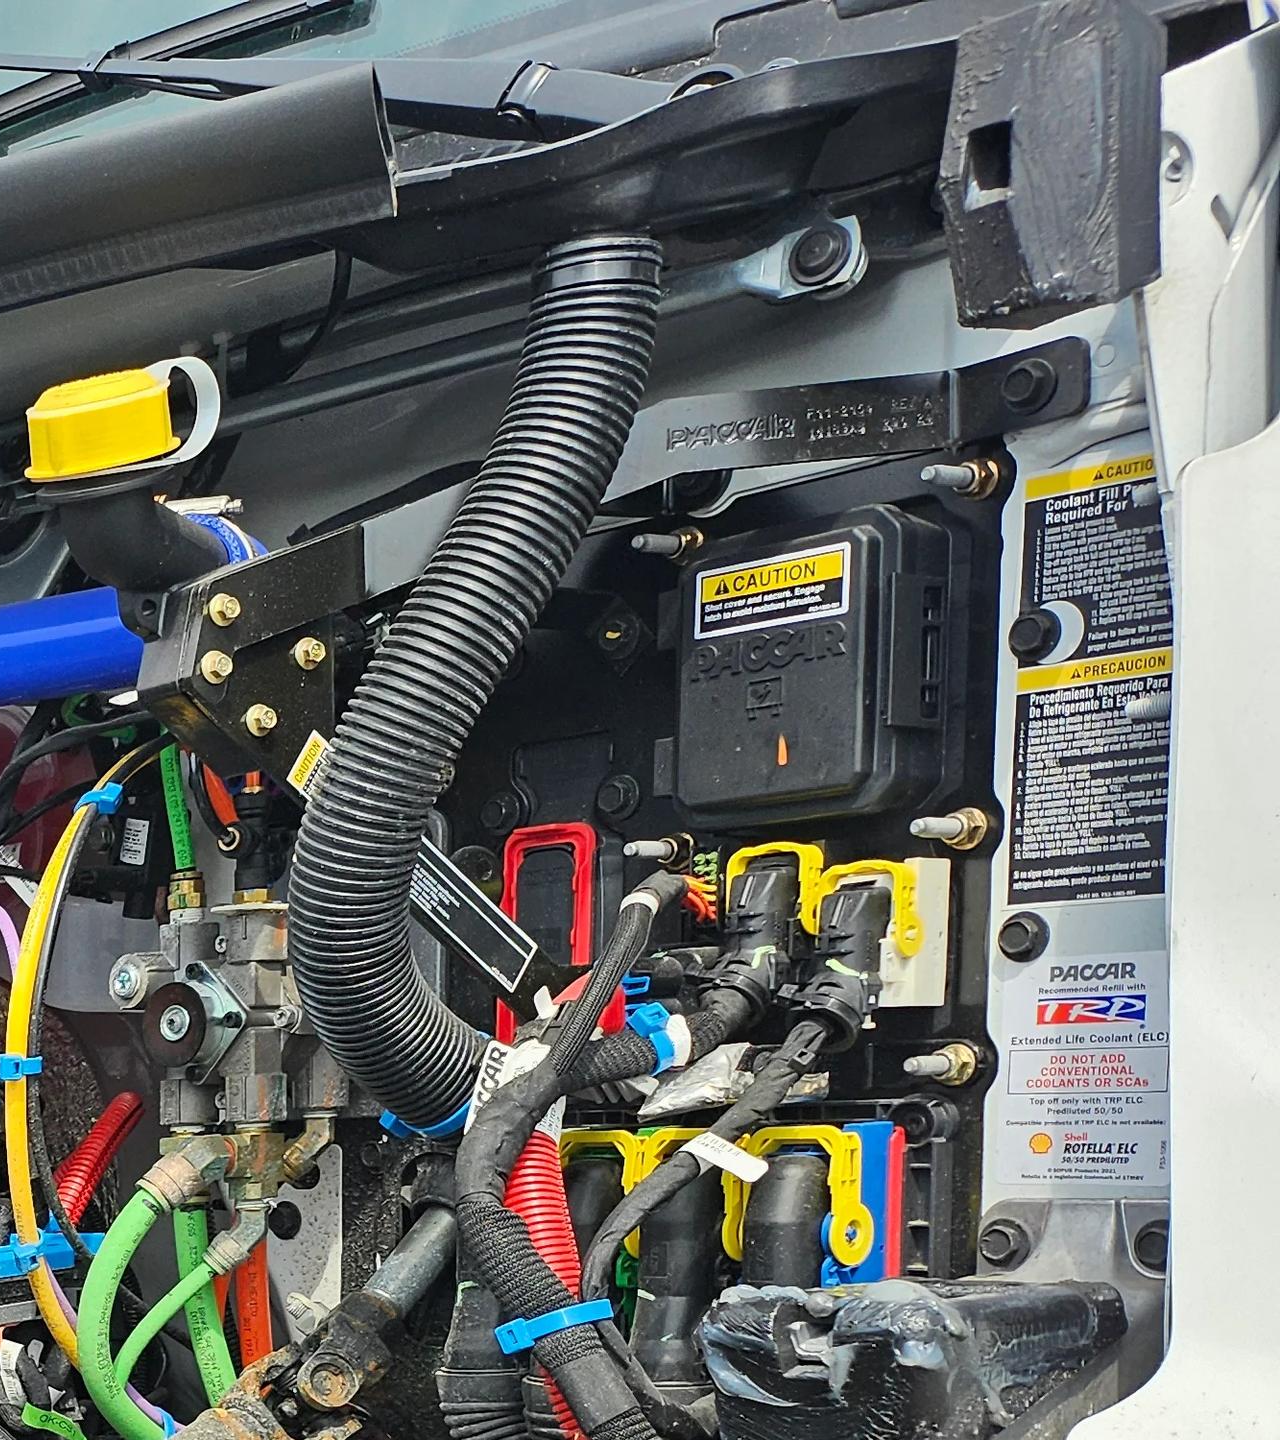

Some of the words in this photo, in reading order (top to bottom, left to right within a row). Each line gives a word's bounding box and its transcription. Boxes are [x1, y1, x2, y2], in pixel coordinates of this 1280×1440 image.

[666, 413, 796, 451] PACCAR
[1106, 458, 1154, 478] CAUTIO
[1046, 492, 1095, 512] Coolant
[1099, 485, 1118, 501] Fill
[1045, 505, 1102, 524] Required
[1107, 500, 1128, 513] For
[733, 562, 816, 592] CAUTION
[690, 622, 848, 682] PACCAR
[1083, 656, 1166, 678] PRECAUCION
[1030, 688, 1094, 705] Procedimiento
[1097, 681, 1144, 697] Requerido
[1147, 677, 1168, 689] Para
[1029, 707, 1041, 718] De
[1043, 698, 1099, 717] Refrigerante
[1102, 698, 1114, 708] En
[295, 741, 320, 783] CAUTION
[1050, 962, 1137, 982] PACCAR
[1039, 986, 1099, 995] Recommended
[1037, 997, 1146, 1022] TRP
[1011, 1036, 1062, 1046] Extended
[1066, 1034, 1085, 1044] Life
[1090, 1033, 1132, 1043] Coolant
[1137, 1031, 1169, 1044] (ELC)
[1050, 1055, 1066, 1064] DO
[1072, 1055, 1096, 1064] NOT
[1100, 1054, 1126, 1063] ADD
[473, 1046, 508, 1115] CCAR
[1041, 1065, 1134, 1076] CONVENTIONAL
[1026, 1078, 1089, 1088] COOLANTS
[1094, 1078, 1111, 1087] OR
[1116, 1077, 1149, 1086] SCAs
[1030, 1098, 1044, 1106] Top
[1048, 1097, 1059, 1105] off
[1062, 1097, 1079, 1105] only
[1104, 1096, 1122, 1104] TRP
[1126, 1096, 1143, 1104] ELC
[1047, 1107, 1091, 1115] Prediluted
[1064, 1133, 1088, 1141] Shell
[1117, 1143, 1138, 1154] ELC
